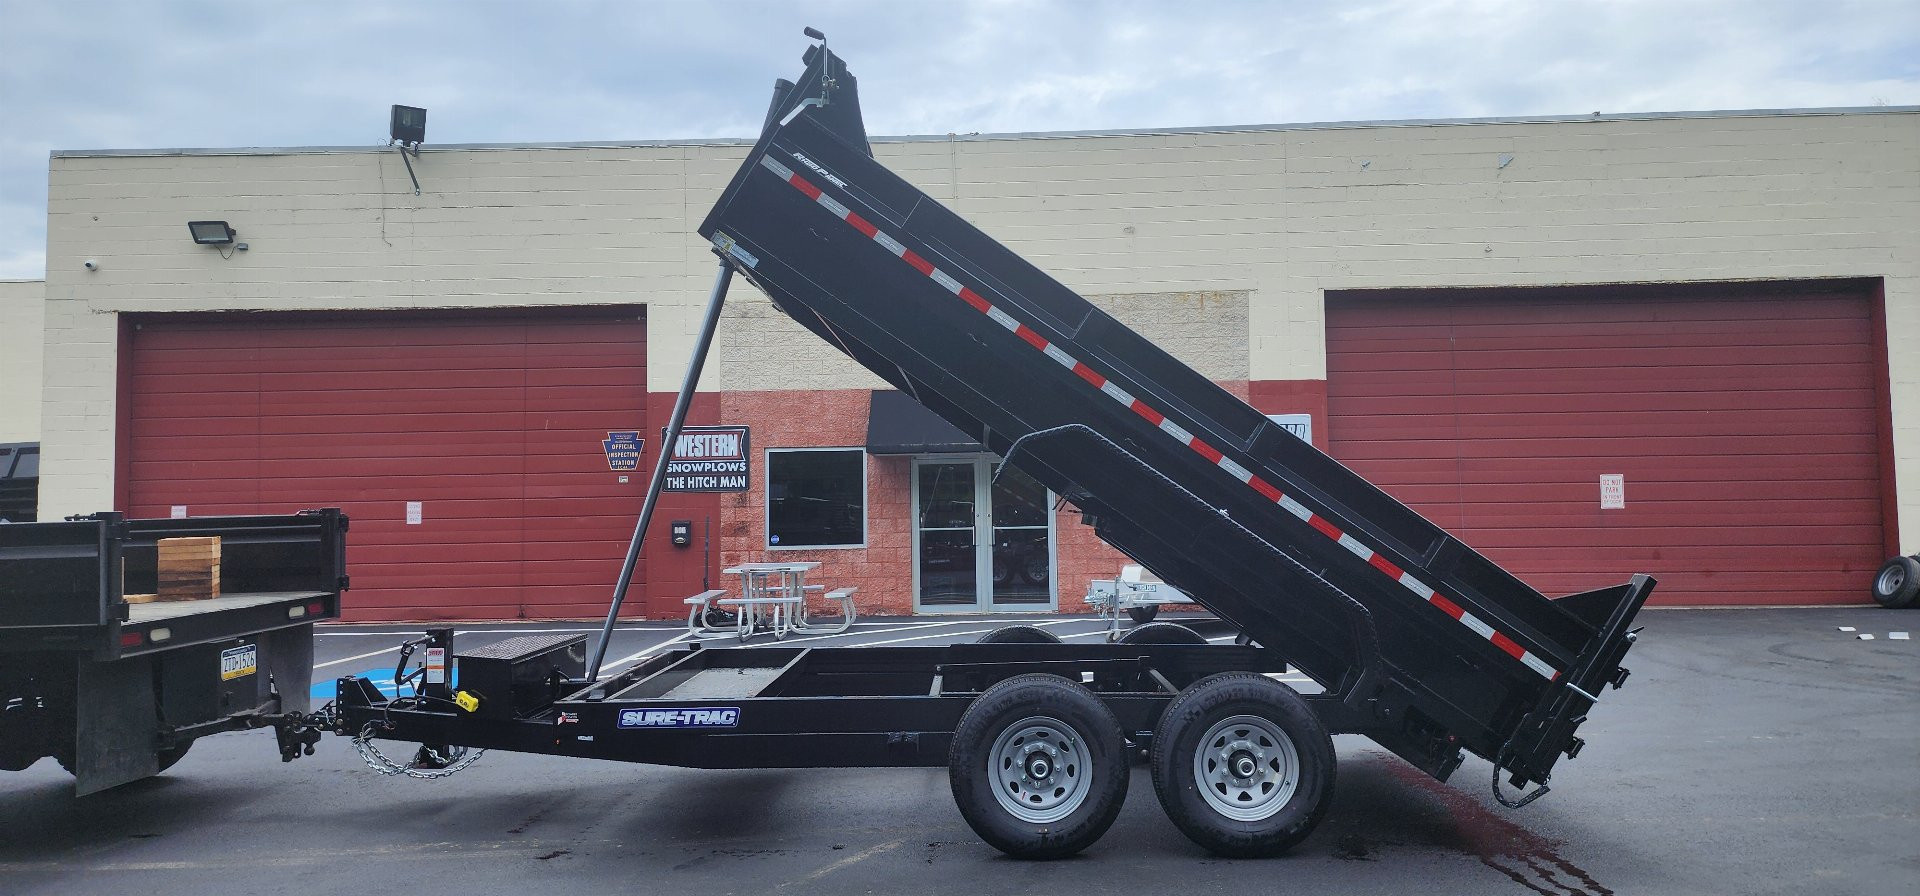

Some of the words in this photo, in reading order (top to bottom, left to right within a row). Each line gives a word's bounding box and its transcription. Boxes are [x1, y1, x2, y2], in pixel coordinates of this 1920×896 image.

[674, 434, 738, 457] WESTERN
[666, 462, 746, 473] SNOWPLOWS
[667, 477, 684, 489] THE
[687, 476, 717, 489] HITCH
[720, 475, 746, 488] MAN
[622, 711, 737, 725] SURE-TRAC
